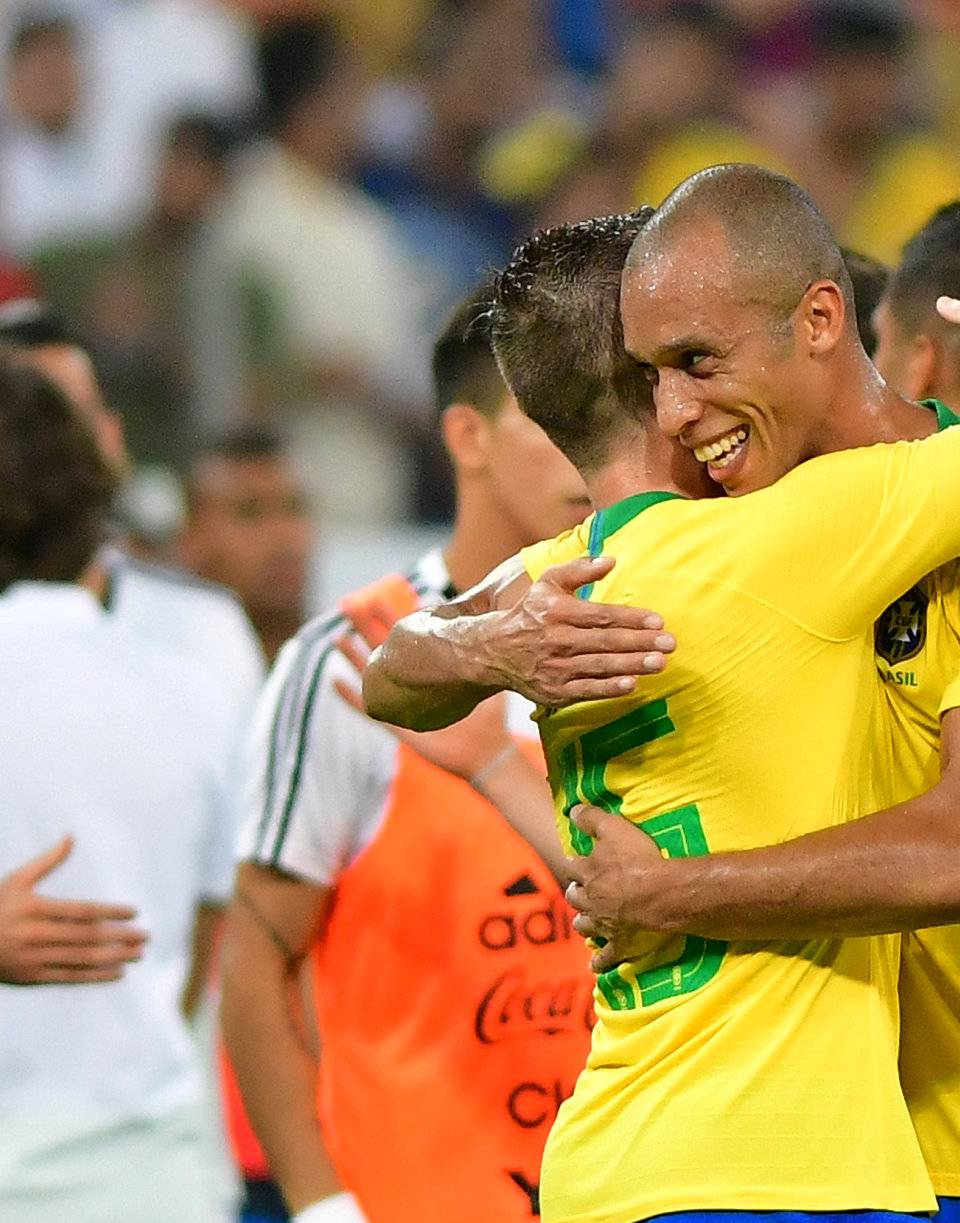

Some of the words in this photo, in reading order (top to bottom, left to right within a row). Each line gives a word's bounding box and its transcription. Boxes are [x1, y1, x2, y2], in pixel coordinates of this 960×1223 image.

[885, 669, 918, 687] ASIL
[479, 898, 572, 951] adi
[509, 1171, 541, 1216] Y
